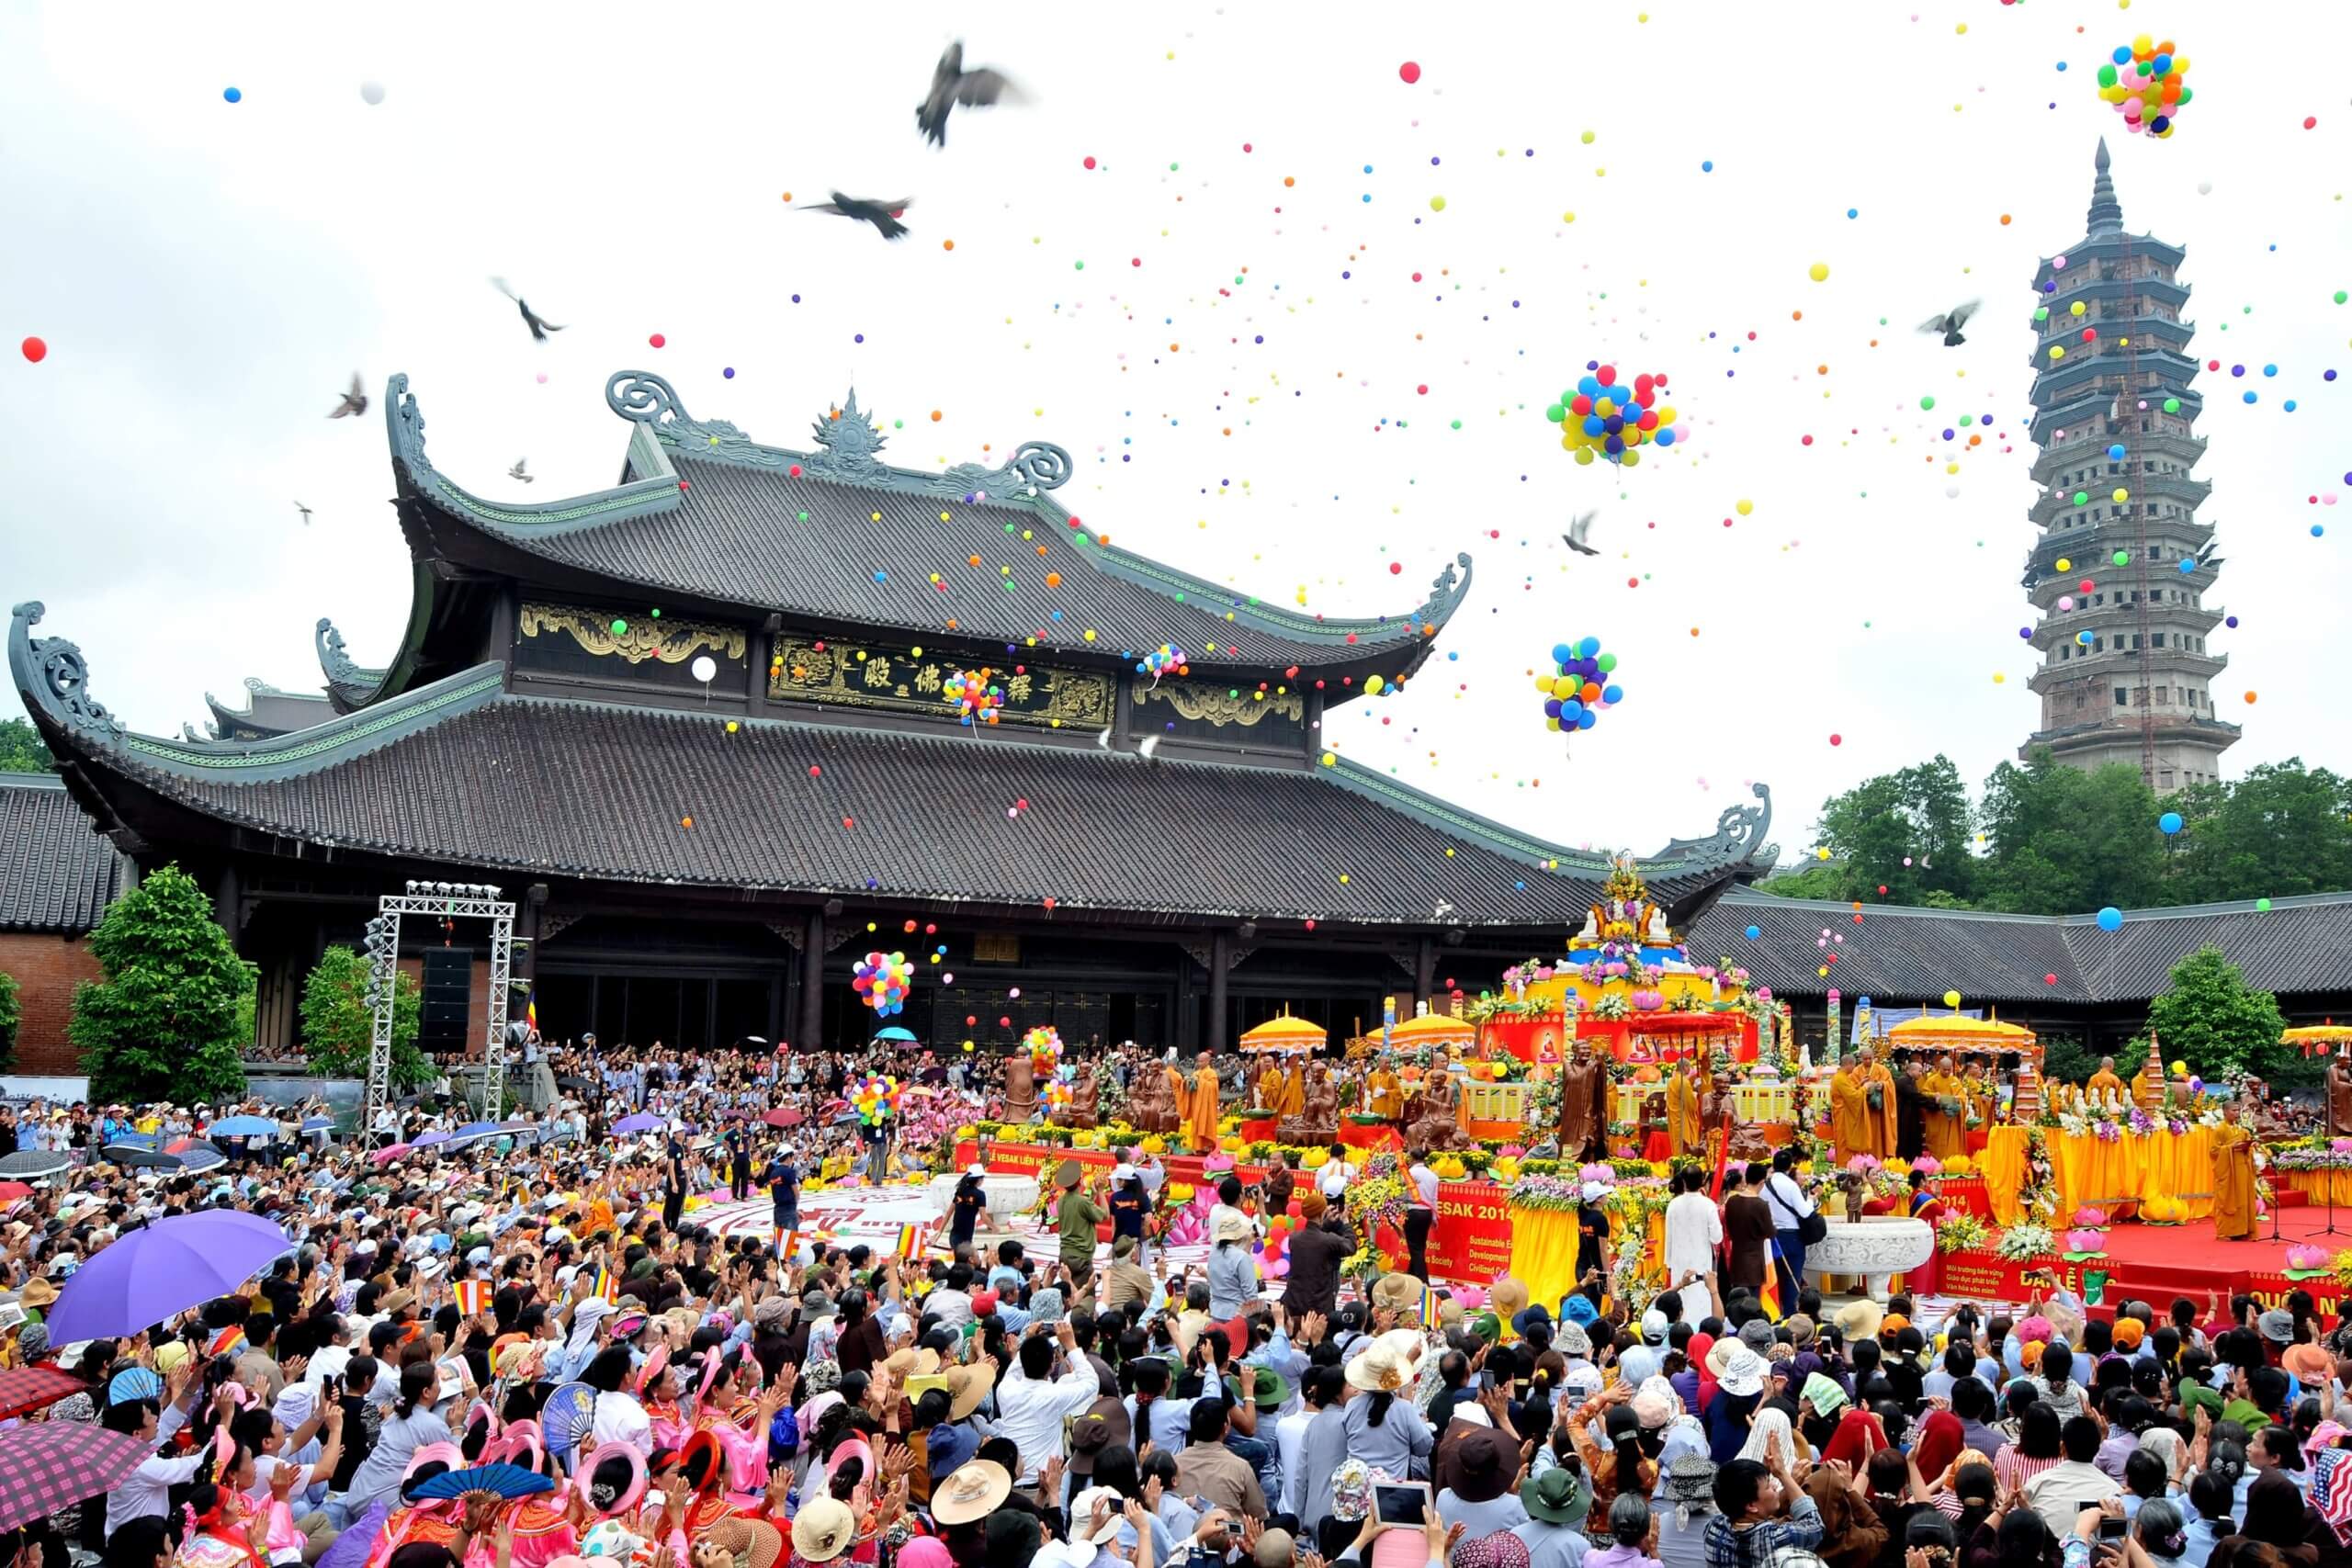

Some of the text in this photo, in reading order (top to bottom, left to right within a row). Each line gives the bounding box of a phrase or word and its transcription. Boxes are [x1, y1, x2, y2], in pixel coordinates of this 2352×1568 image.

[1942, 1195, 1966, 1207] 014
[1438, 1201, 1474, 1218] ESAK
[1469, 1235, 1505, 1248] Sustainable
[1431, 1255, 1453, 1269] Society
[1469, 1249, 1509, 1263] Development
[1469, 1263, 1495, 1273] Civilized
